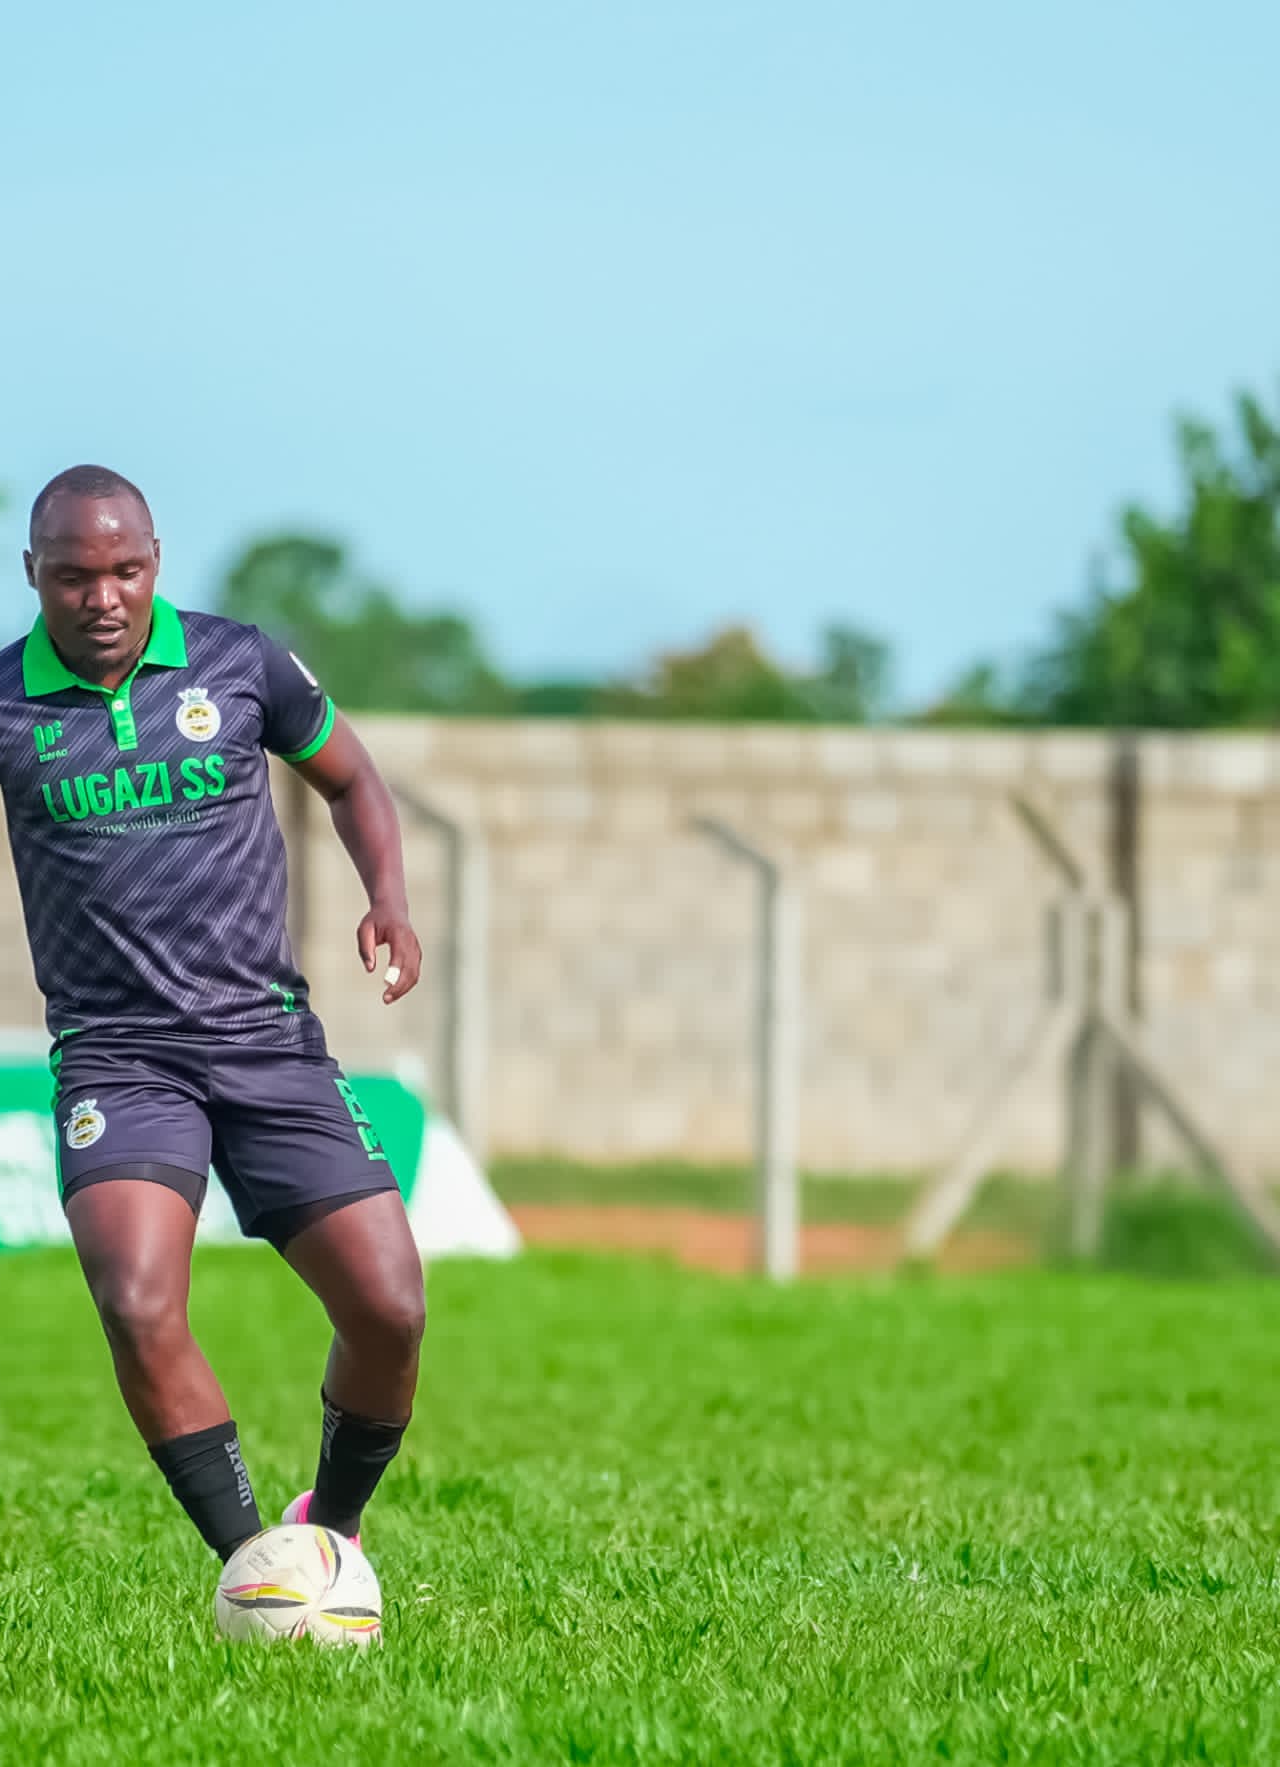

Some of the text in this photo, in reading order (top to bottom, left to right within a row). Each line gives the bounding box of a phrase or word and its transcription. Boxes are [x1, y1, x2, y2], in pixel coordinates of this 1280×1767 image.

[42, 754, 226, 823] LUGAZI SS
[86, 807, 201, 838] Strive with Faith
